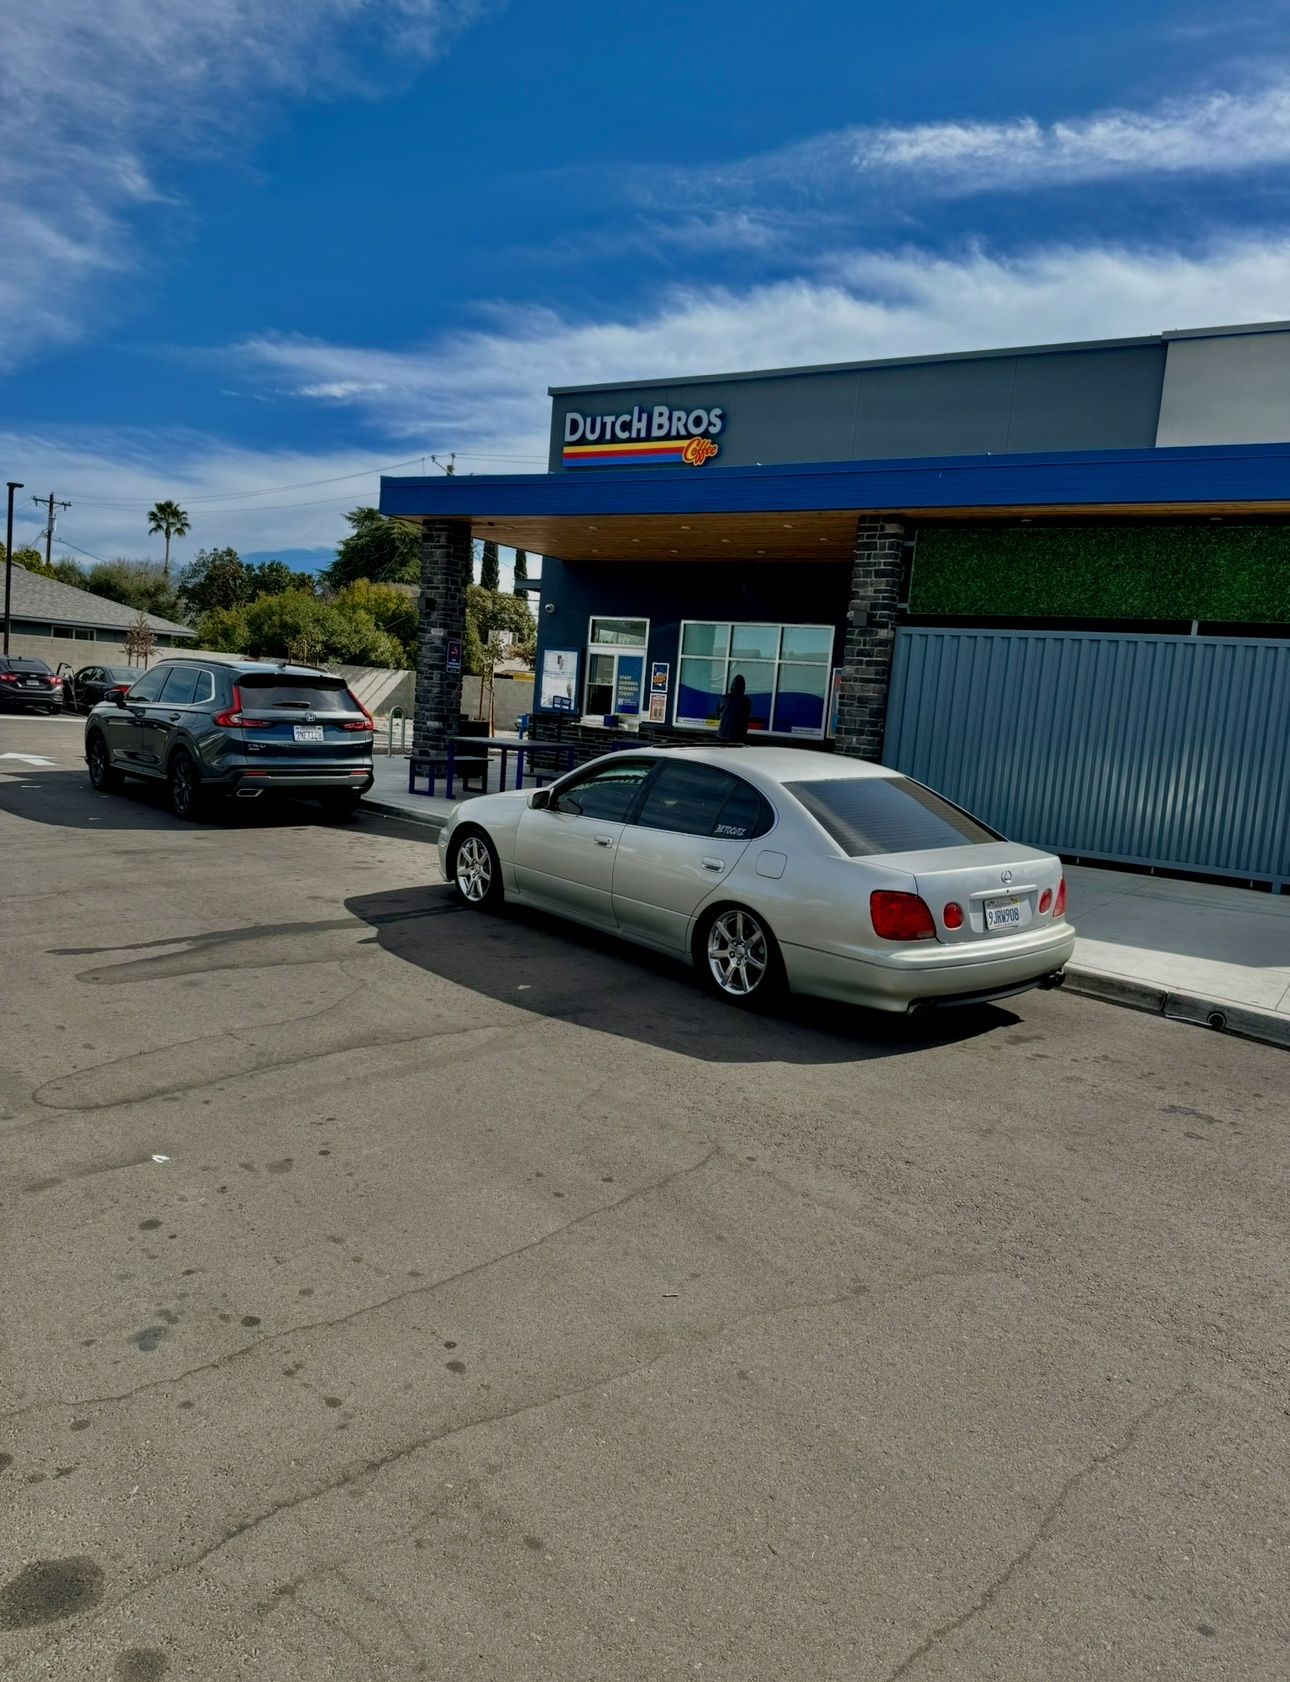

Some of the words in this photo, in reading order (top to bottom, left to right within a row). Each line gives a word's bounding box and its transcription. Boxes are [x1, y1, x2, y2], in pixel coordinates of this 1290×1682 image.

[564, 406, 648, 442] DUTCH
[651, 405, 723, 437] BROS
[682, 437, 719, 466] Coffee
